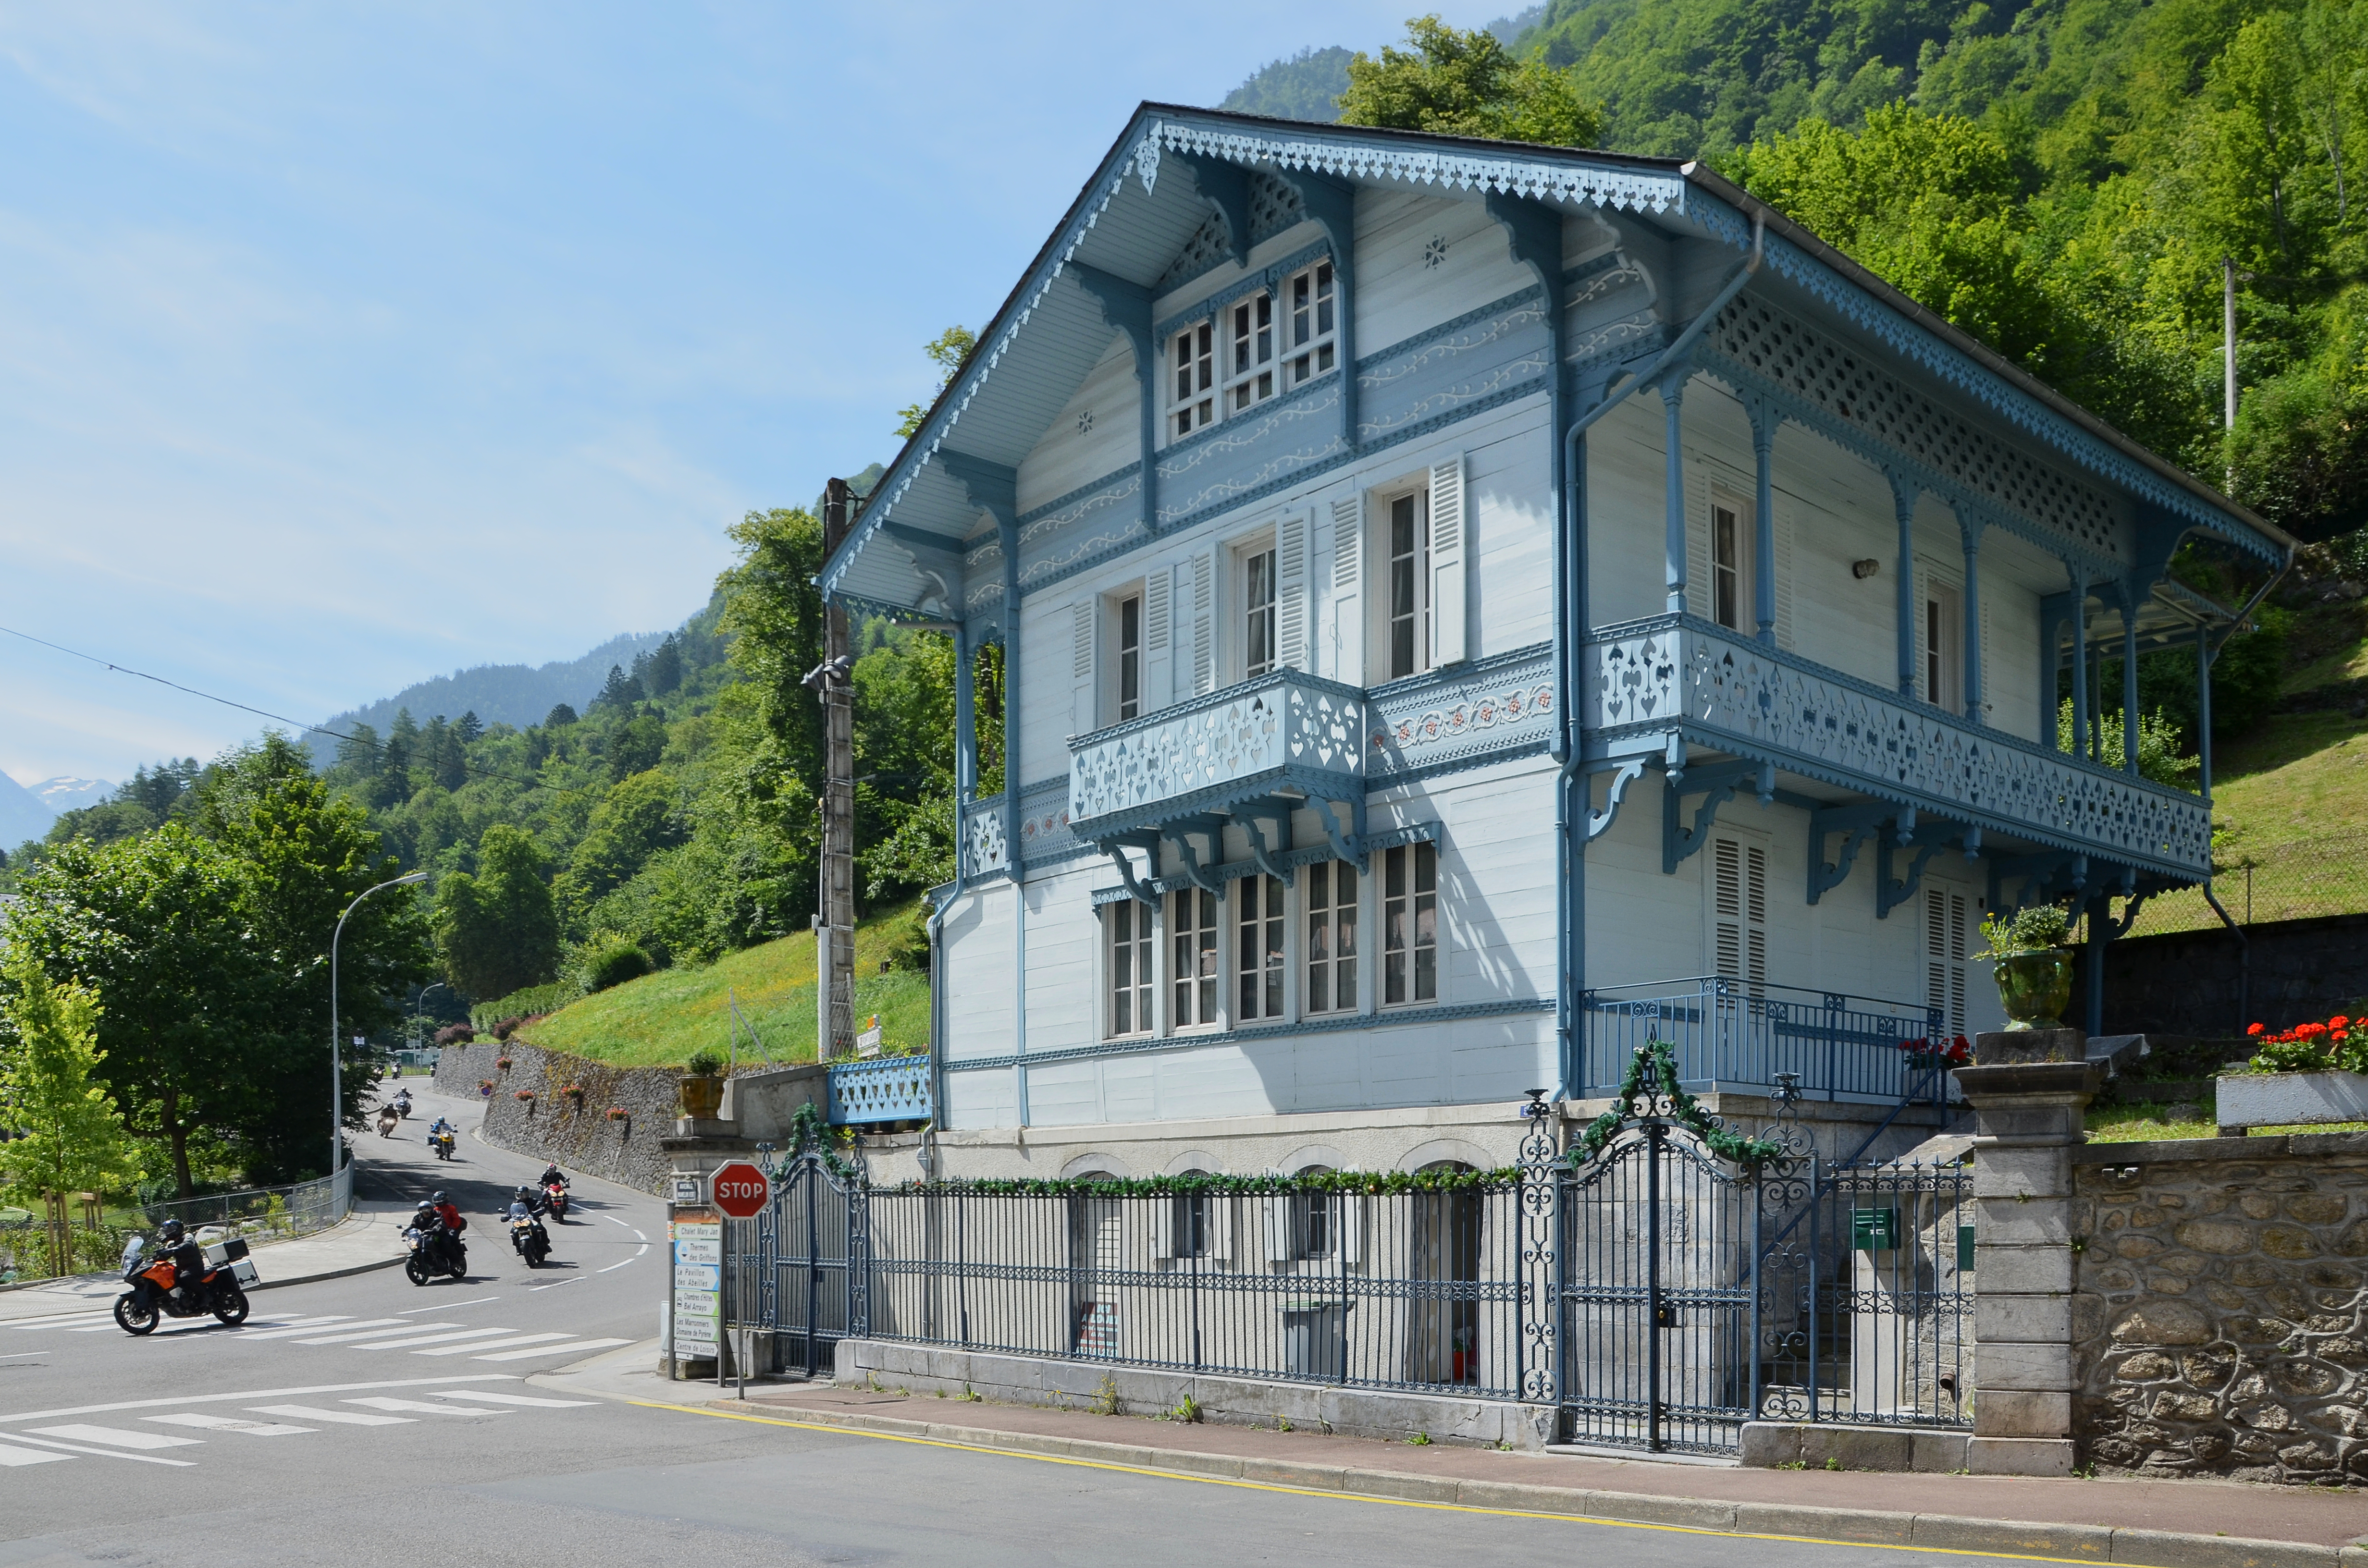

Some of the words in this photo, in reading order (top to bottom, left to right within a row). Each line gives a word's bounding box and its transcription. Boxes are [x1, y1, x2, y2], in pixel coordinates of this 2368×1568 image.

[719, 1182, 763, 1199] STOP
[675, 1209, 703, 1218] Cauterets
[698, 1227, 708, 1237] Mary
[699, 1254, 717, 1262] Griffons
[685, 1268, 704, 1276] Pavillon
[688, 1279, 707, 1287] Abeilles
[692, 1303, 707, 1312] Arrayo
[1097, 1304, 1110, 1314] ICI
[685, 1318, 709, 1327] Marronniers
[677, 1327, 691, 1336] Domaine
[677, 1342, 691, 1350] Centre
[700, 1345, 715, 1354] Loisirs
